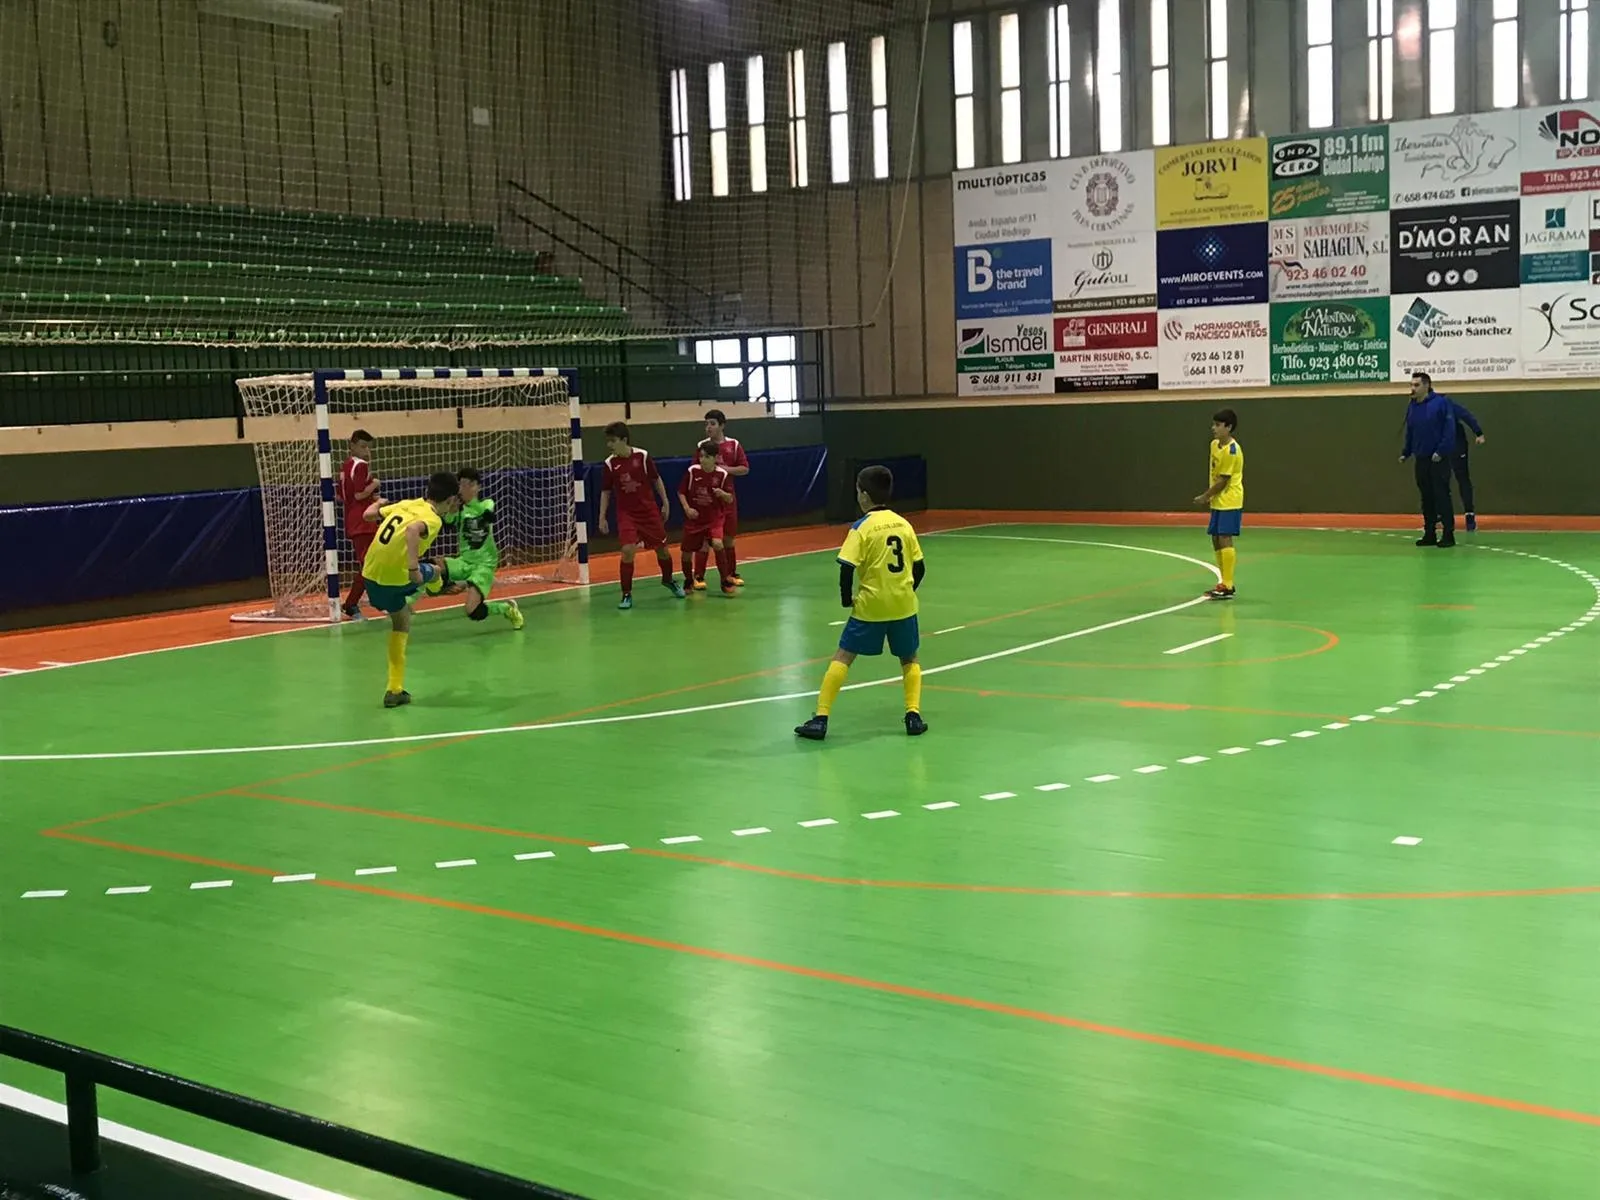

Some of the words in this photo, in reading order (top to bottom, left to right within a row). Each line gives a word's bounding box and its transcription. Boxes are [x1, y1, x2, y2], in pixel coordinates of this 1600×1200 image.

[1324, 134, 1358, 156] 89.1
[1361, 133, 1385, 152] fm
[1278, 146, 1314, 158] ONDA
[1158, 148, 1203, 175] COMERCIAL
[1181, 157, 1237, 176] JORVI
[1280, 162, 1314, 173] CERO
[1323, 156, 1351, 176] Ciudad
[1353, 153, 1385, 173] Rodrigo
[1570, 169, 1589, 181] 923
[1592, 168, 1600, 179] 4
[1404, 193, 1421, 203] 658
[1424, 191, 1438, 201] 474
[1439, 190, 1455, 200] 625
[1273, 228, 1283, 240] M
[1285, 227, 1294, 239] S
[1398, 223, 1510, 249] D'MORAN
[1525, 229, 1587, 246] JAGRAMA
[1274, 244, 1283, 256] S
[1285, 243, 1295, 255] M
[967, 248, 993, 293] B
[996, 268, 1013, 279] the
[1014, 264, 1043, 278] travel
[1286, 269, 1309, 281] 923
[1312, 267, 1328, 280] 46
[1331, 266, 1347, 279] 02
[1350, 264, 1367, 277] 40
[996, 278, 1027, 290] brand
[1304, 307, 1315, 320] LA
[1464, 315, 1497, 325] Jesús
[1017, 323, 1044, 337] Yesos
[1087, 320, 1148, 336] GENERALI
[1194, 320, 1260, 331] HORMIGONES
[1301, 318, 1355, 338] NATURAL
[1423, 328, 1463, 338] Alfonso
[1465, 326, 1512, 337] Sánchez
[1184, 330, 1230, 341] FRANCISCO
[1232, 328, 1268, 339] MATEOS
[986, 331, 1048, 353] Ismael
[1136, 351, 1152, 360] S.C.
[1191, 352, 1207, 361] 923
[1209, 351, 1220, 361] 46
[1222, 350, 1232, 360] 12
[1234, 350, 1244, 360] 81
[1280, 354, 1306, 369] Tlfo.
[1309, 356, 1330, 371] 923
[1332, 353, 1354, 369] 480
[1357, 352, 1378, 368] 625
[1463, 357, 1489, 365] Ciudad
[1490, 356, 1516, 365] Rodrigo
[1190, 366, 1206, 376] 664
[1209, 365, 1217, 374] 11
[1220, 365, 1231, 374] 88
[1233, 364, 1244, 374] 97
[1272, 373, 1280, 383] C/
[1281, 372, 1300, 381] Santa
[1301, 371, 1320, 381] Clara
[1333, 370, 1358, 380] Ciudad
[1359, 369, 1388, 380] Rodrigo
[983, 374, 1000, 384] 608
[1004, 373, 1021, 382] 911
[1026, 372, 1042, 382] 431
[379, 515, 404, 545] 6
[886, 535, 904, 573] 3
